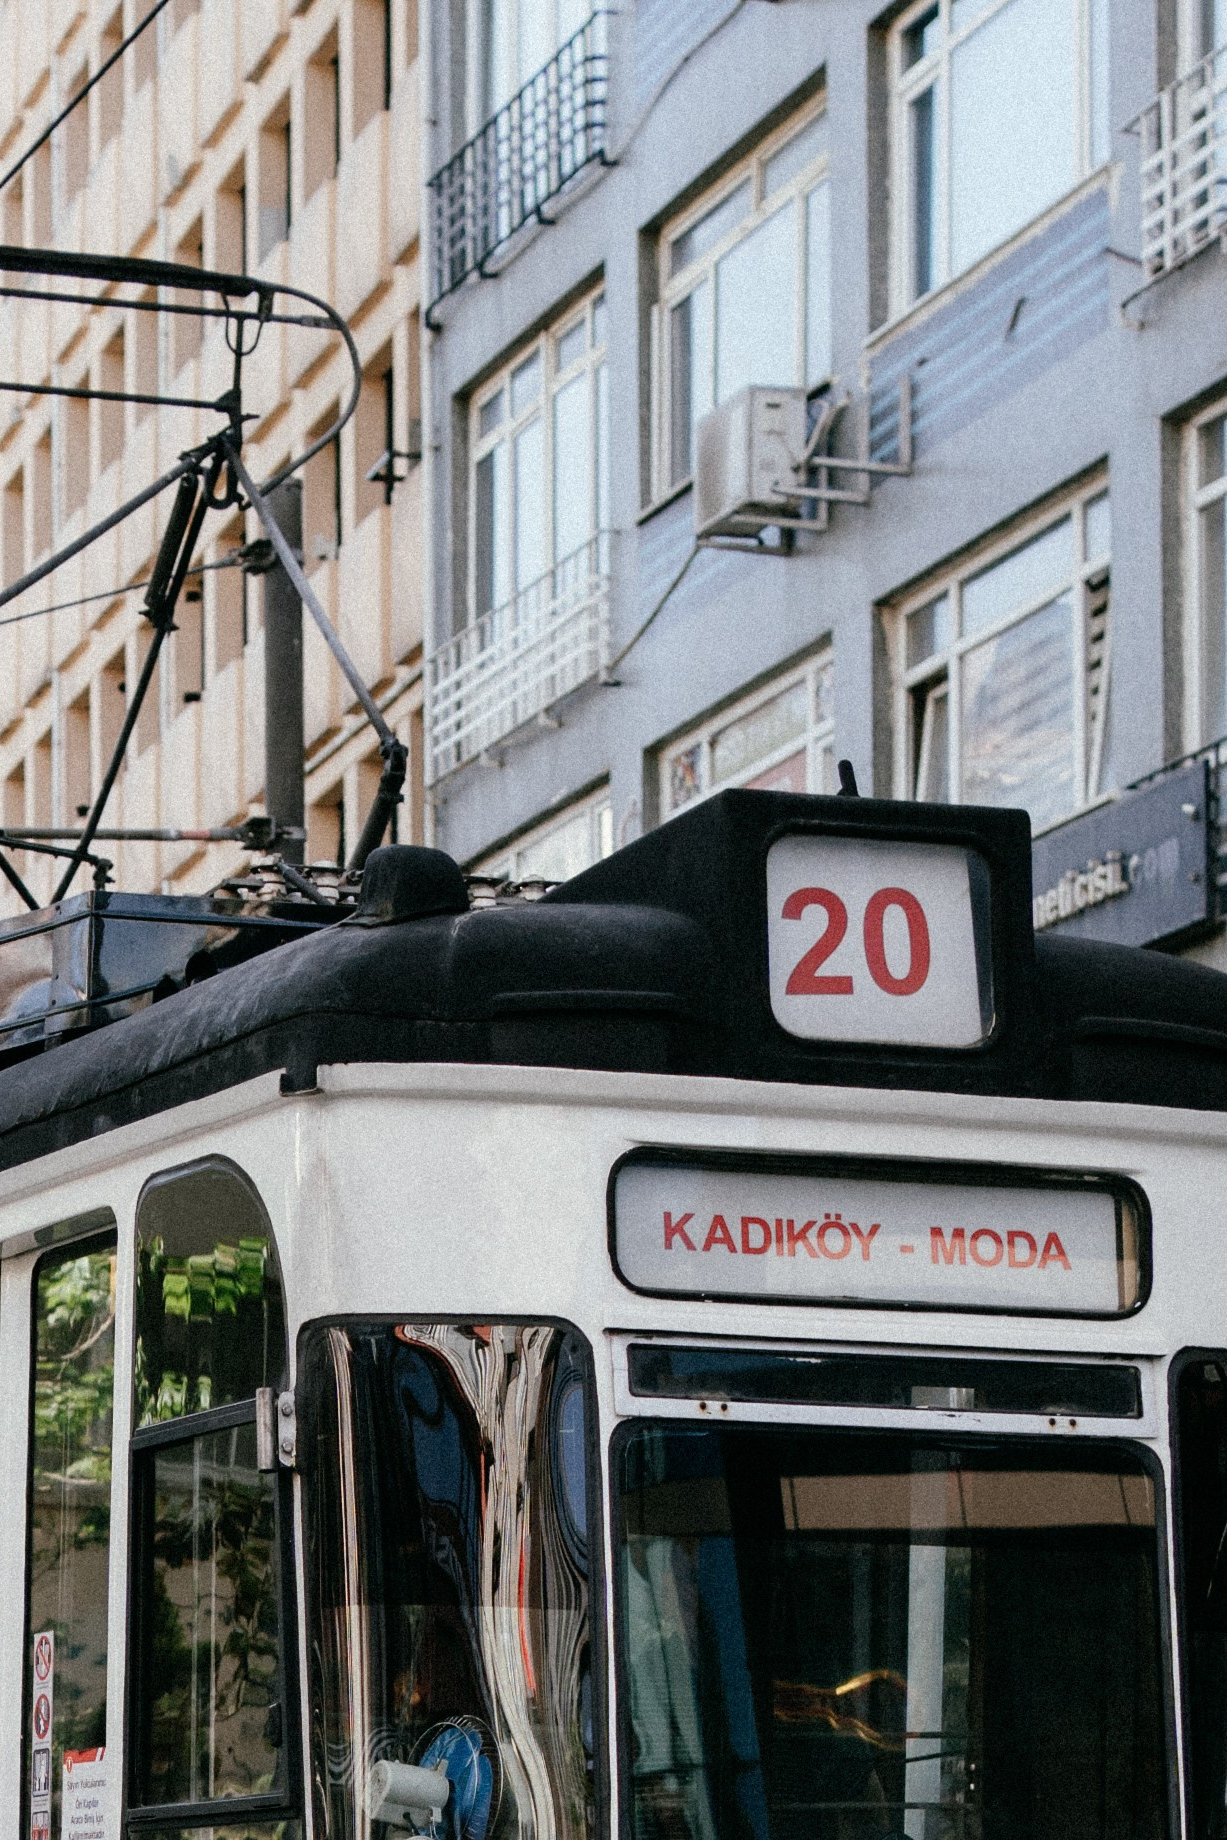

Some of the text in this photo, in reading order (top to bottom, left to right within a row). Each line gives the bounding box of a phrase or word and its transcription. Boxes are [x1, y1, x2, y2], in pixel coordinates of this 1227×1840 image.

[780, 886, 932, 997] 20
[662, 1211, 882, 1262] KADIKÖY
[930, 1226, 1073, 1272] MODA
